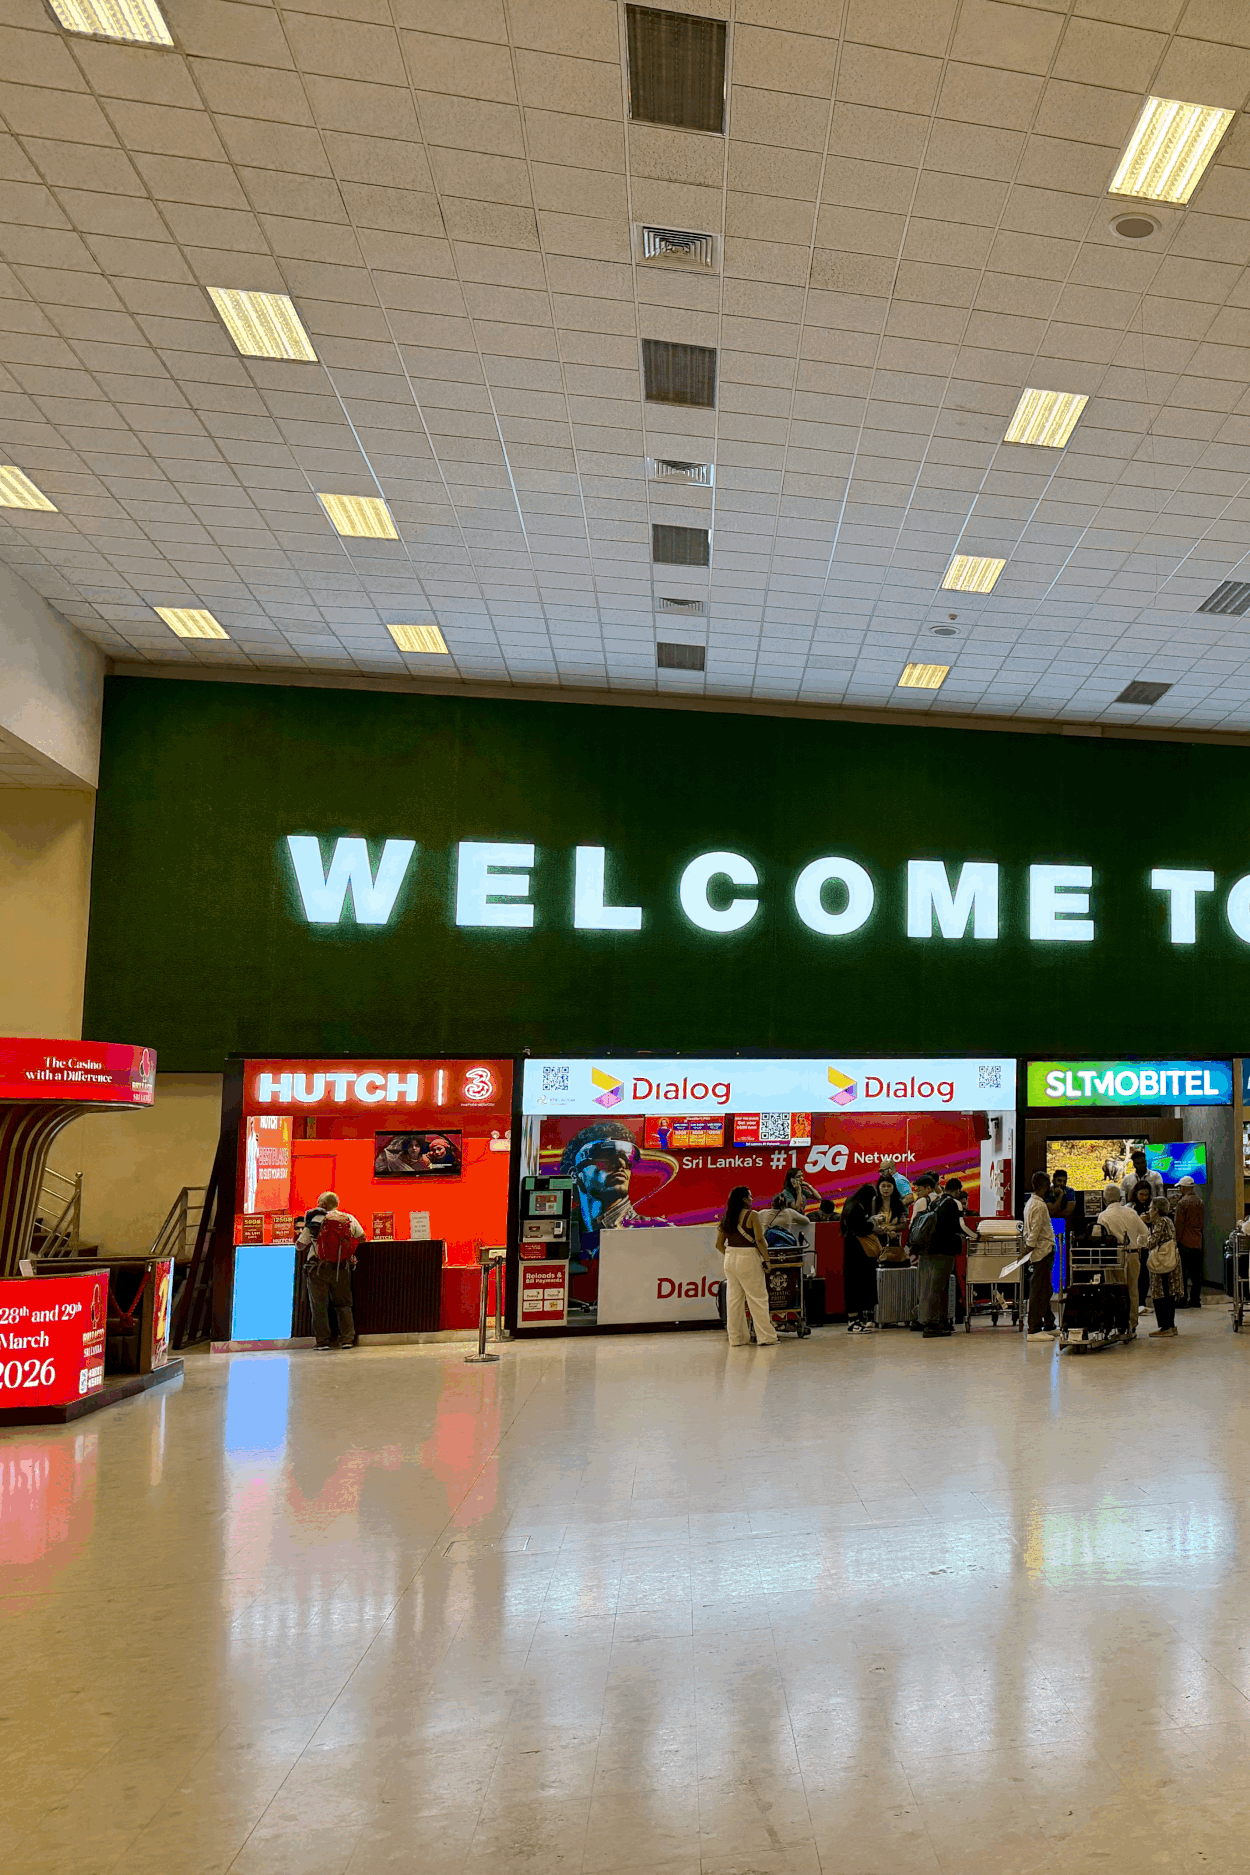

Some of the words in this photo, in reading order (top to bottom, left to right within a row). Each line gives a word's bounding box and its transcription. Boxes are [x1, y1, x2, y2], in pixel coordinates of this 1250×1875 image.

[287, 835, 1095, 941] WELCOME
[26, 1069, 53, 1080] with
[63, 1070, 113, 1083] Difference
[43, 1056, 67, 1068] The
[68, 1059, 102, 1070] Casino
[258, 1072, 419, 1103] HUTCH
[464, 1067, 493, 1100] 3
[633, 1077, 731, 1105] Dialog
[865, 1076, 954, 1103] Dialog
[682, 1156, 703, 1169] Sri
[707, 1155, 763, 1169] Lanka's
[770, 1150, 797, 1170] #1
[804, 1145, 850, 1173] 5G
[854, 1150, 916, 1164] Network
[525, 1271, 555, 1279] Reloads
[31, 1304, 59, 1323] and
[61, 1302, 82, 1321] 29th
[0, 1330, 50, 1350] March
